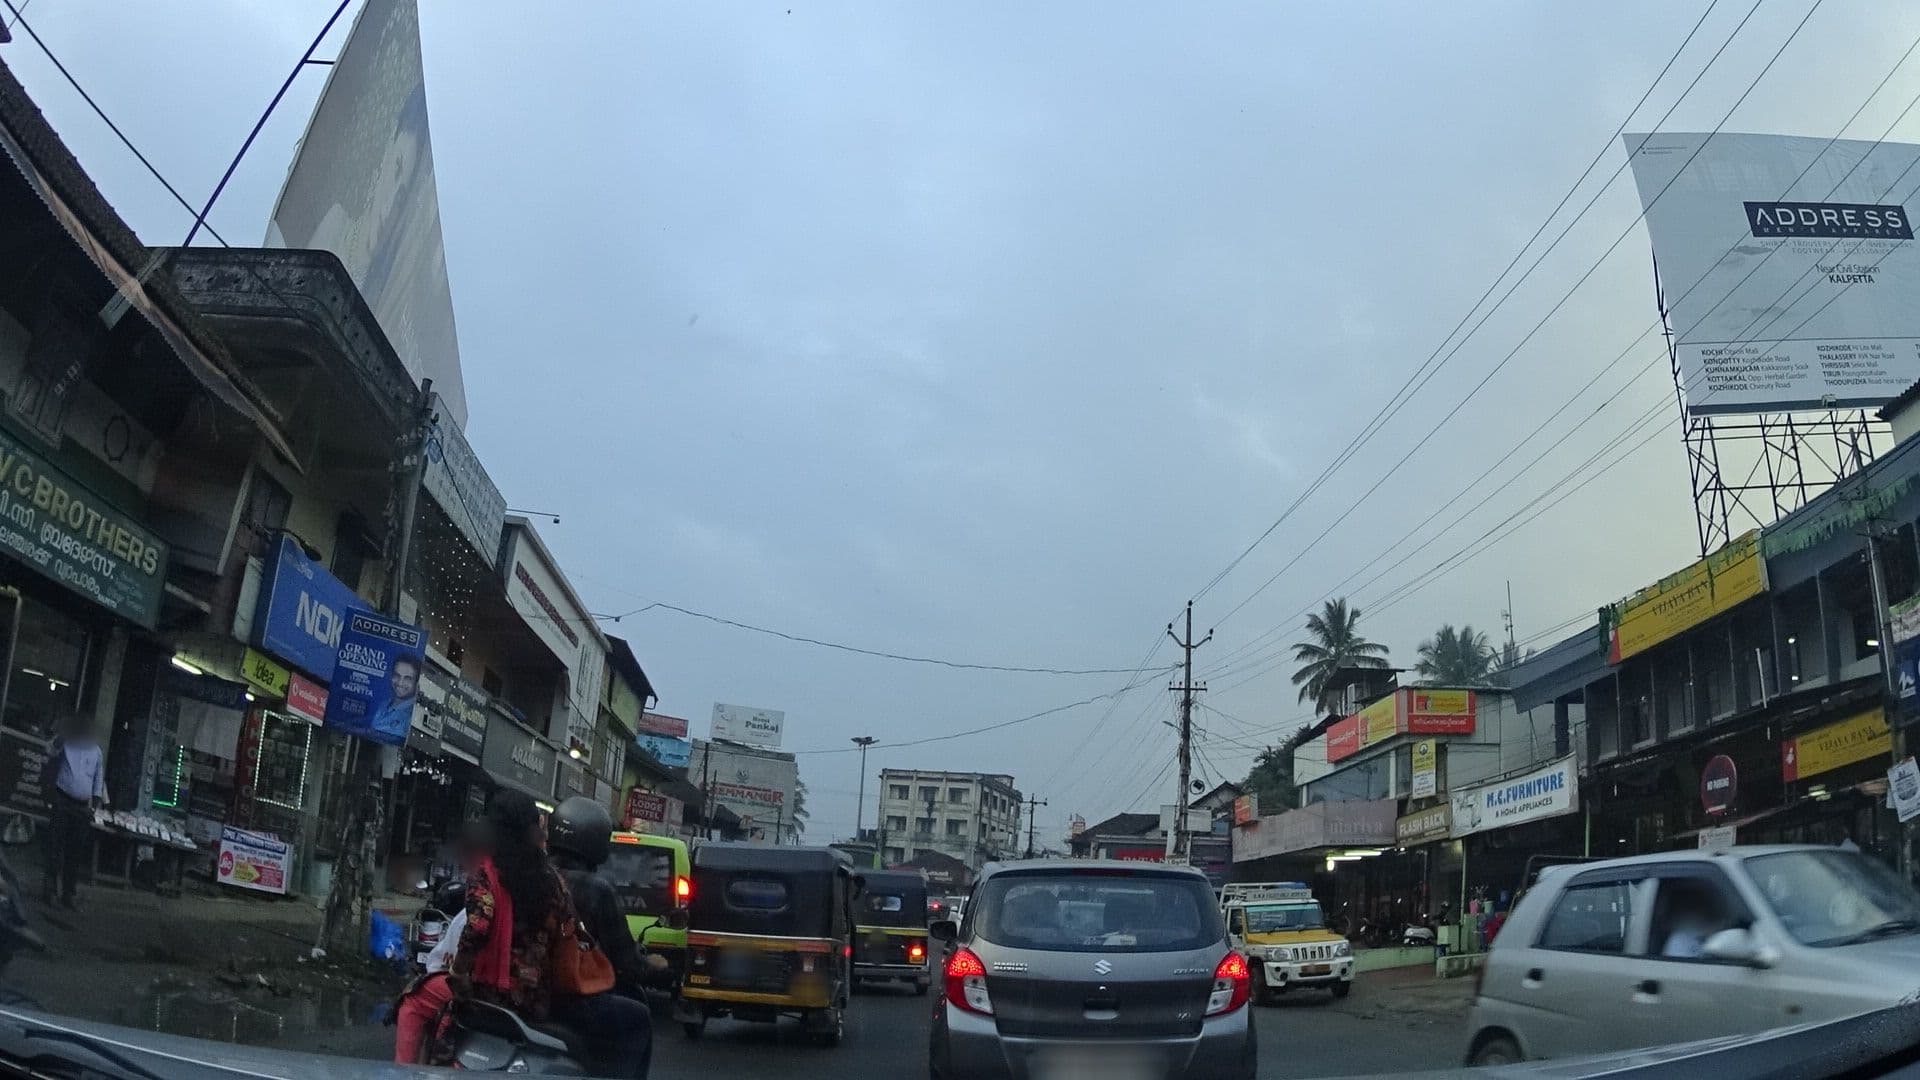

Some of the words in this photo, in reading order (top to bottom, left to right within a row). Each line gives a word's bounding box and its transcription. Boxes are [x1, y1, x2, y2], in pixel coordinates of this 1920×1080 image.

[1757, 208, 1902, 228] ADDRESS
[1836, 263, 1853, 273] Civil
[1853, 263, 1881, 273] Station
[1828, 274, 1876, 284] KALPETTA
[1708, 383, 1748, 392] KOZHIKODE
[354, 618, 418, 643] ADDRESS
[338, 649, 388, 671] OPENING
[344, 642, 386, 661] GRAND
[745, 719, 779, 734] Pankaj
[631, 798, 663, 812] LODGE
[1500, 806, 1518, 817] HOME
[1518, 796, 1553, 813] APPLIANCES
